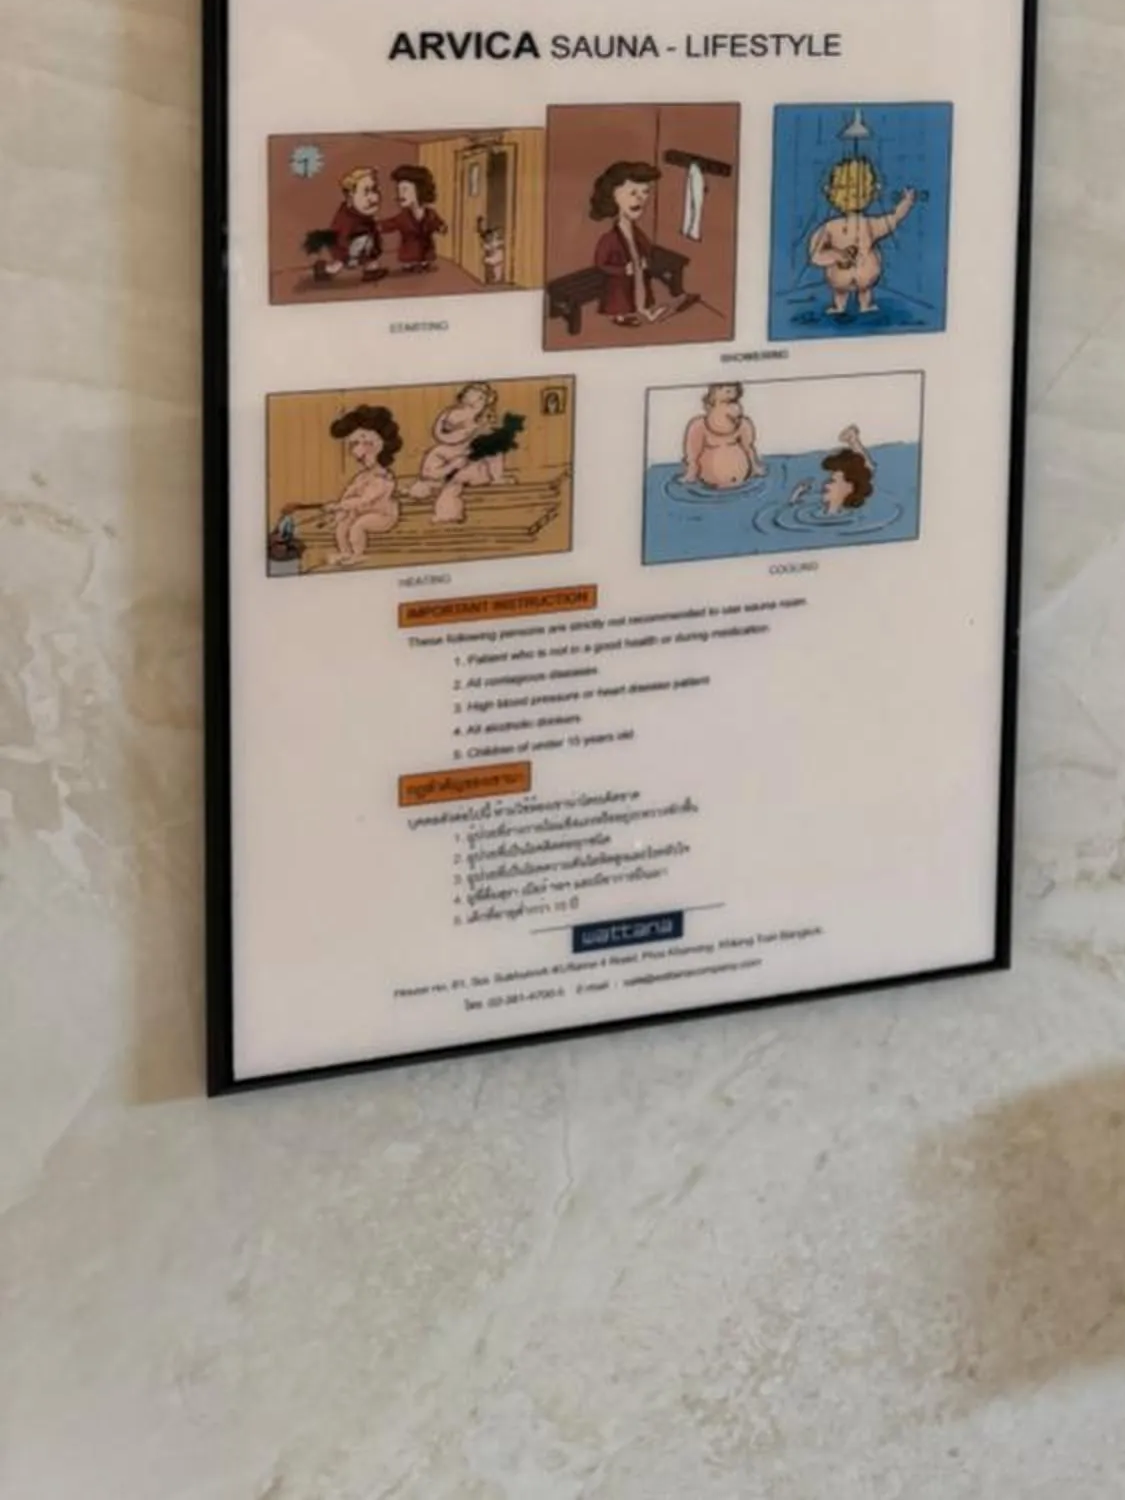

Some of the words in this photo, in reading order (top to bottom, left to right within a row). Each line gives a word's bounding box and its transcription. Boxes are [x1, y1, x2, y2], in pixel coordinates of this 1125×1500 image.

[387, 30, 541, 60] ARVICA
[550, 34, 660, 59] SAUNA
[685, 33, 841, 57] LIFESTYLE
[405, 600, 489, 619] IMPORTANT
[493, 591, 589, 611] INSTRUCTION
